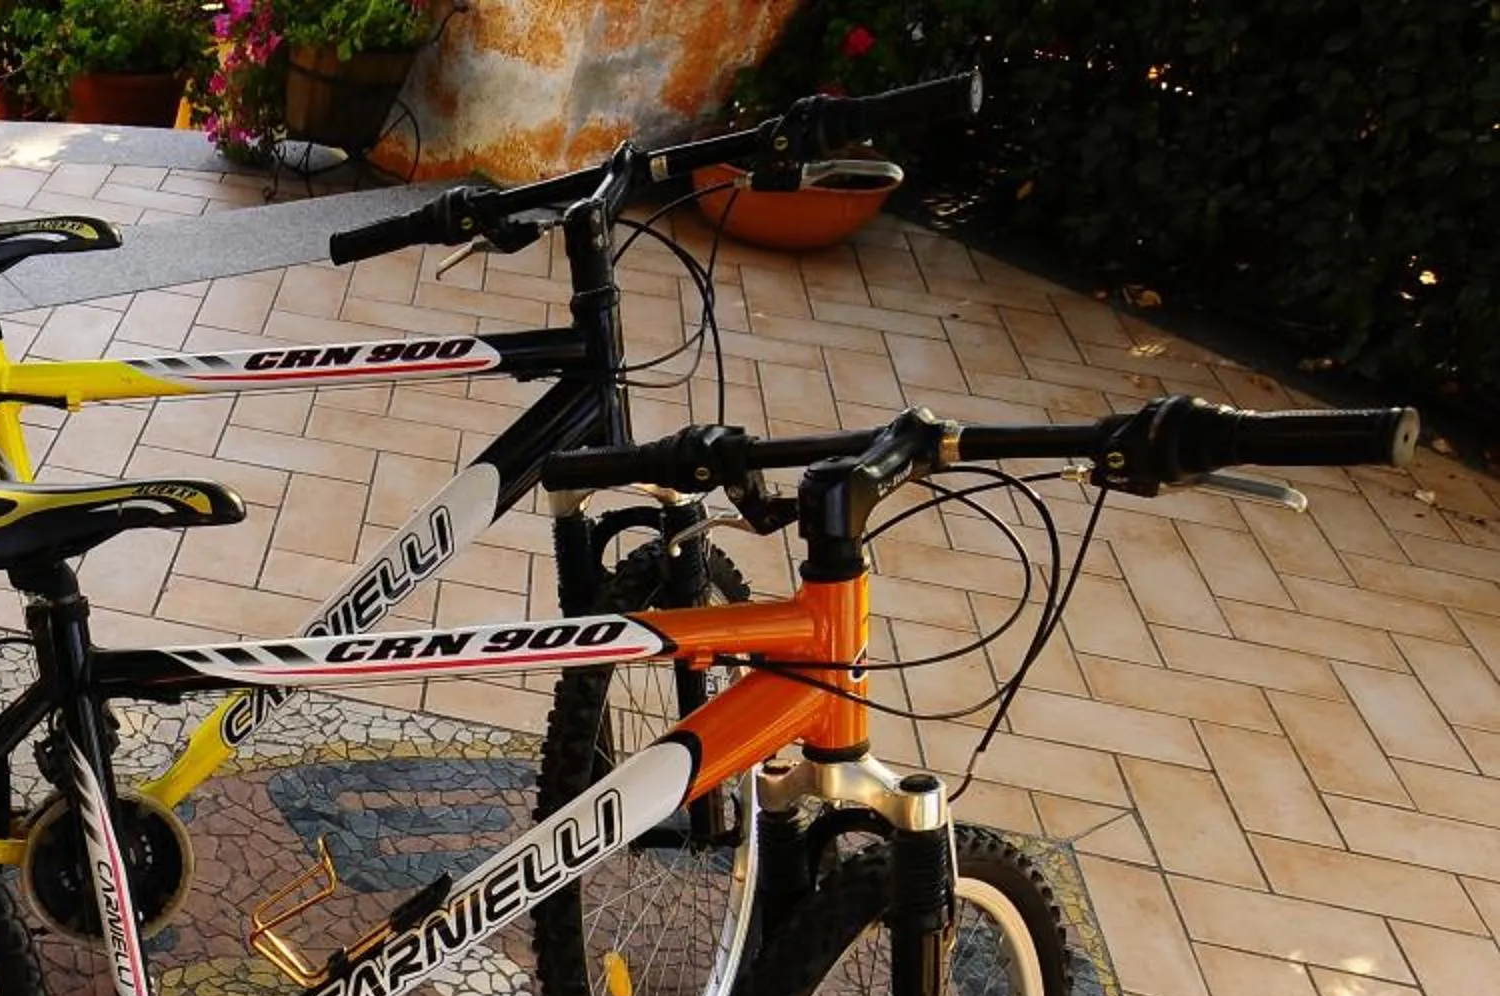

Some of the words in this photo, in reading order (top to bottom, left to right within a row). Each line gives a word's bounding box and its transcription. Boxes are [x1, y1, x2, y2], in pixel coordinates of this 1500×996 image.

[243, 345, 364, 371] CRN
[364, 338, 478, 363] 900
[219, 504, 455, 750] CAIELLI
[324, 631, 478, 663] CRN
[479, 621, 629, 653] 900
[97, 859, 135, 989] CARNIELLI
